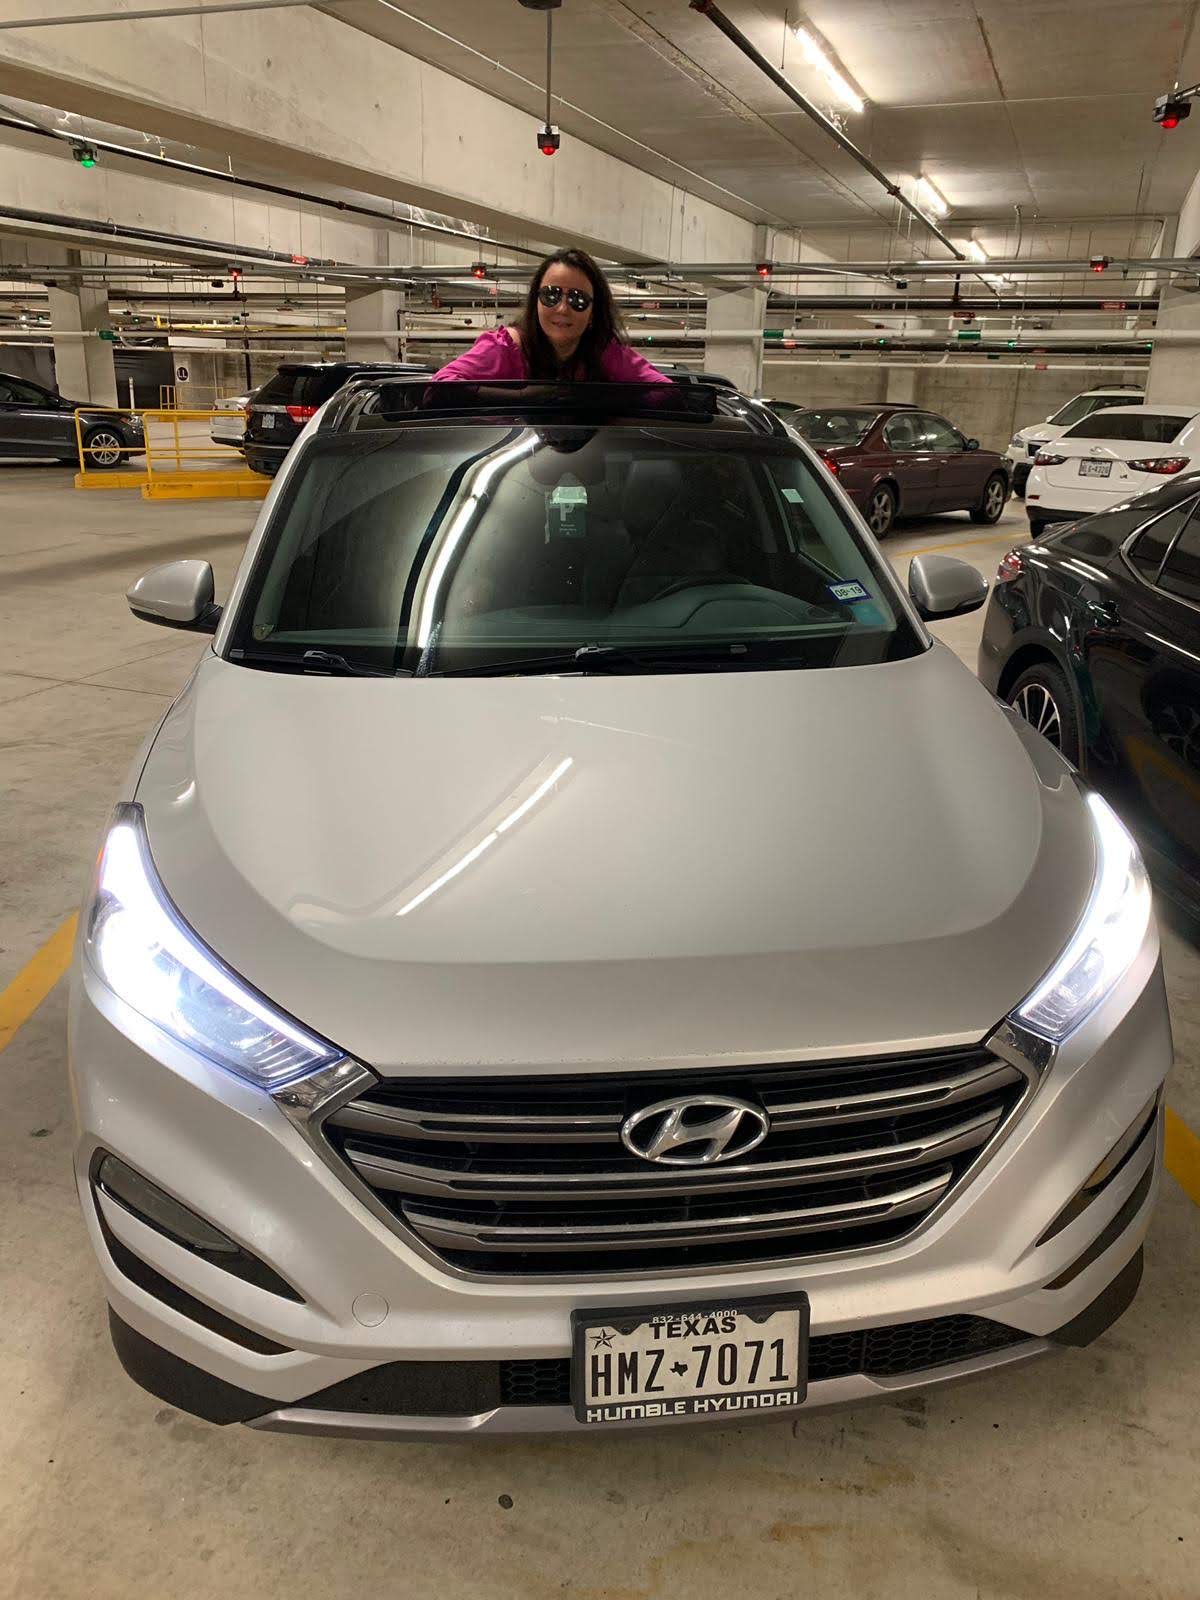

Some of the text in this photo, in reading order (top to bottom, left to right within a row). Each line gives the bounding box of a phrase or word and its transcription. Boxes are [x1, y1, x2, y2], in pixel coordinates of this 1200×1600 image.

[649, 1316, 737, 1340] TEXAS
[652, 1309, 738, 1324] 832-644-4000
[691, 1338, 789, 1389] 7071
[587, 1391, 798, 1423] HUMBLE HYUNDAI
